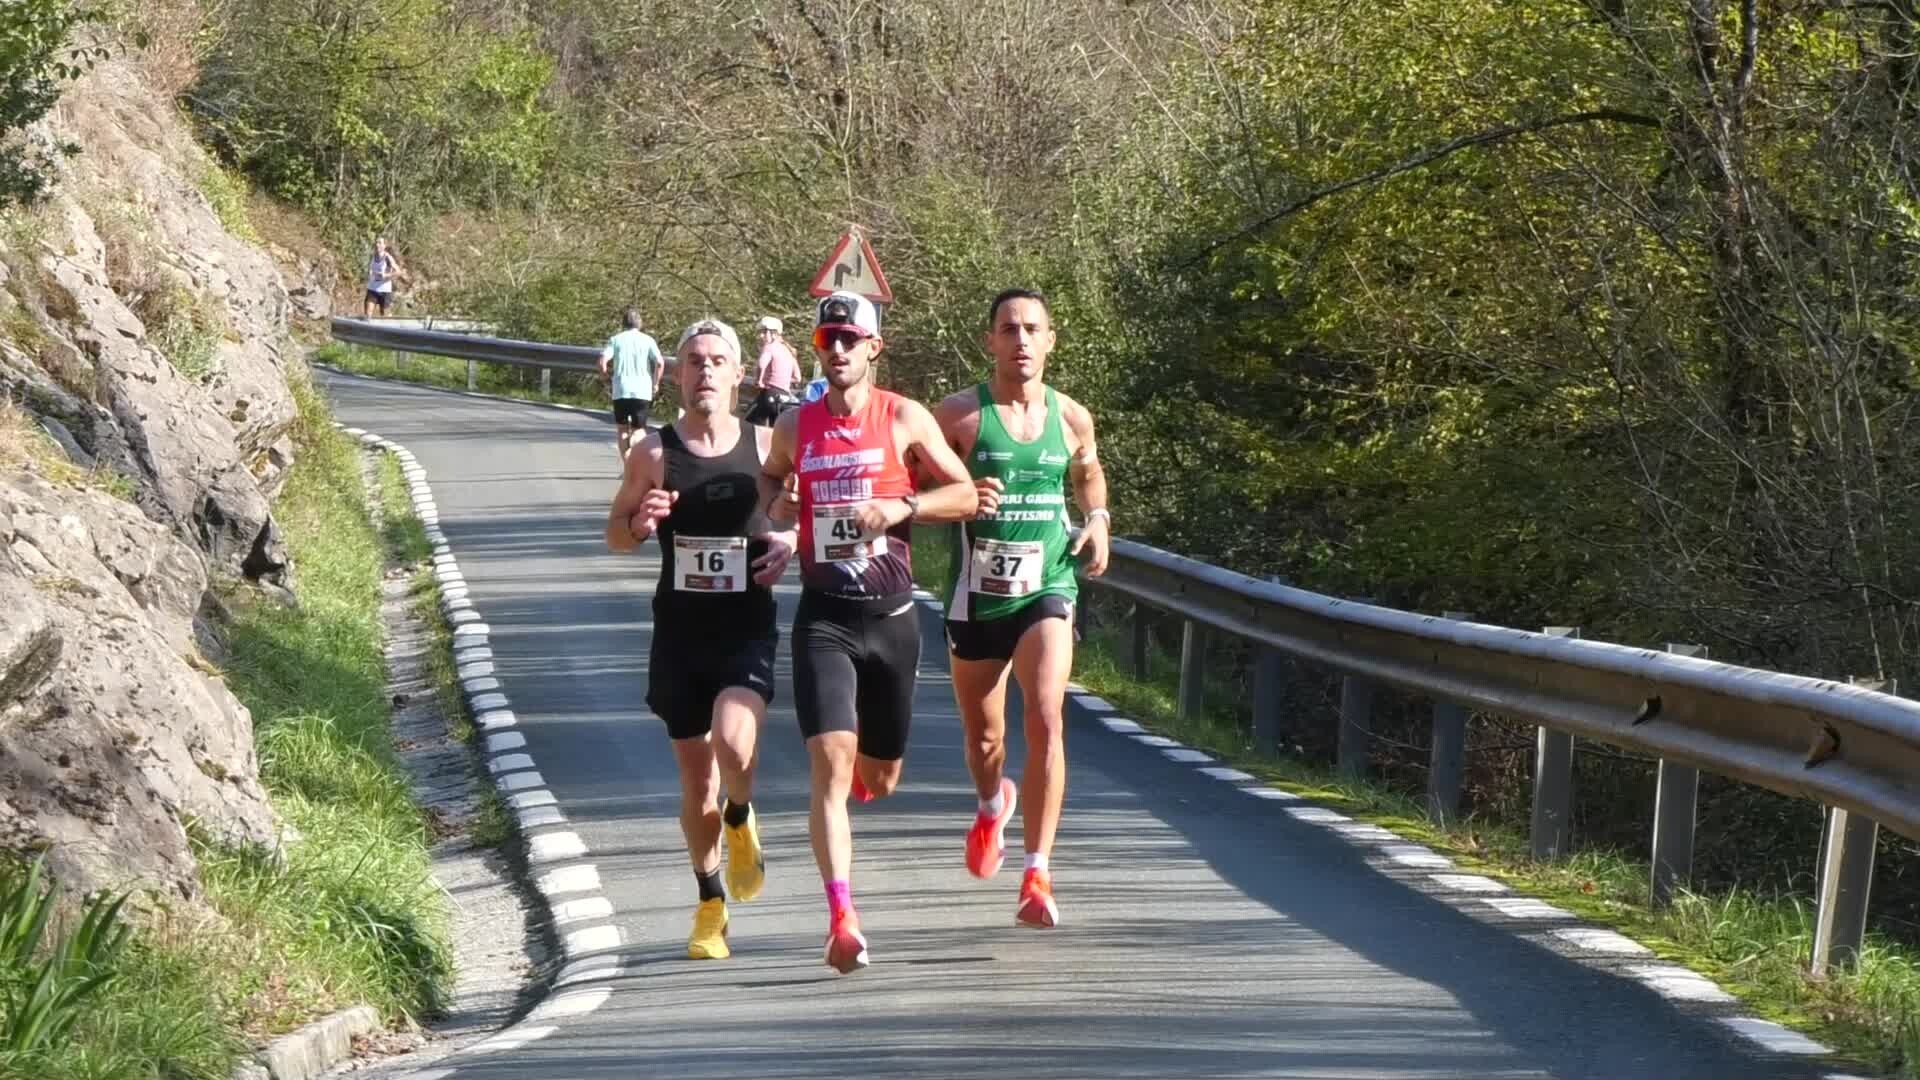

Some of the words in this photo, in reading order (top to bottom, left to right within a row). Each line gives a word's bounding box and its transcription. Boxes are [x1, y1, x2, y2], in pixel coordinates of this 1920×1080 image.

[976, 510, 1055, 521] ATLETISMO
[831, 519, 862, 540] 45
[694, 551, 725, 573] 16
[991, 555, 1023, 577] 37
